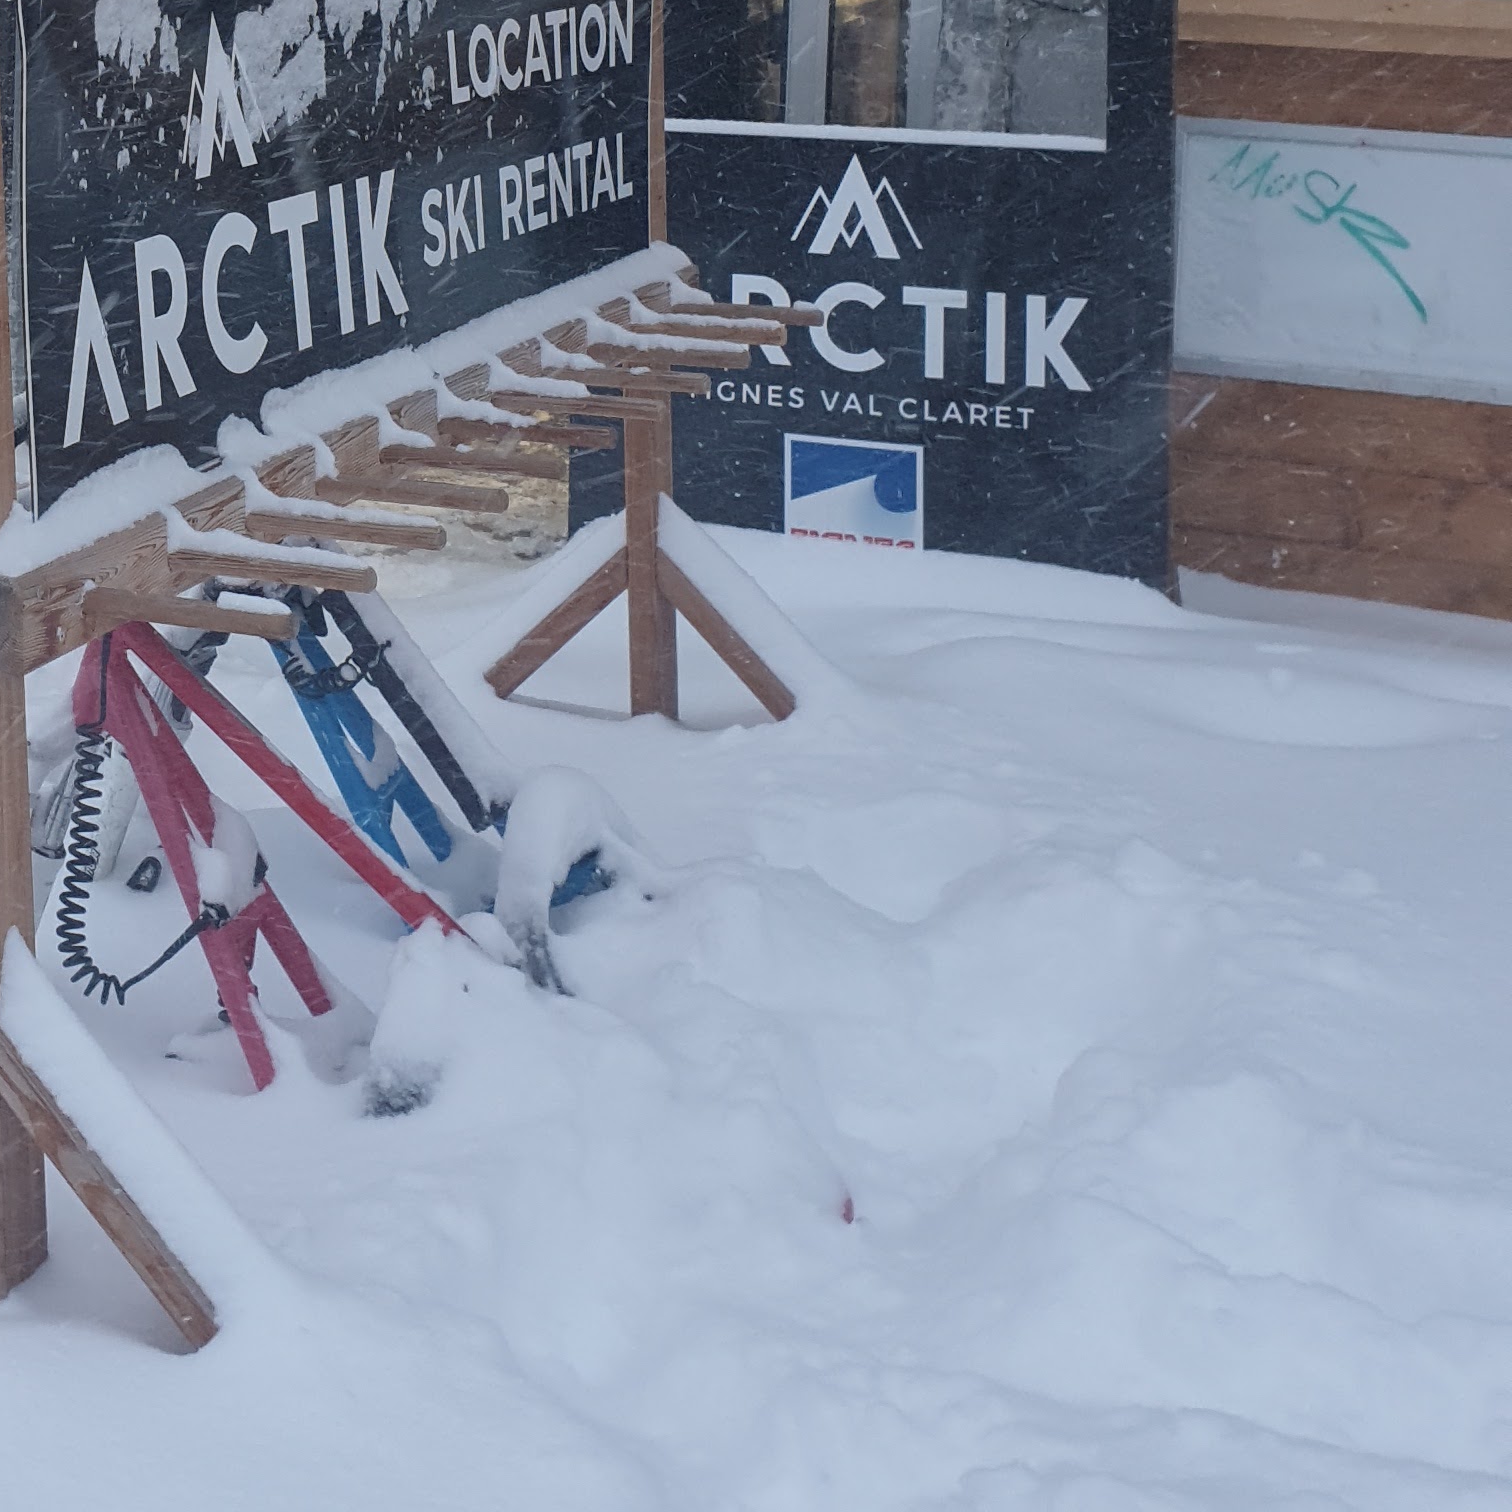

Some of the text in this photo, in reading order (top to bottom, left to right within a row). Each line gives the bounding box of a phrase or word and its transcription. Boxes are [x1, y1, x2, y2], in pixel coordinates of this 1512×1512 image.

[63, 132, 634, 448] ARCTIK SKI RENTAL
[731, 273, 1092, 393] RCTIK
[820, 389, 883, 417] VAL
[898, 396, 1035, 433] CLARET
